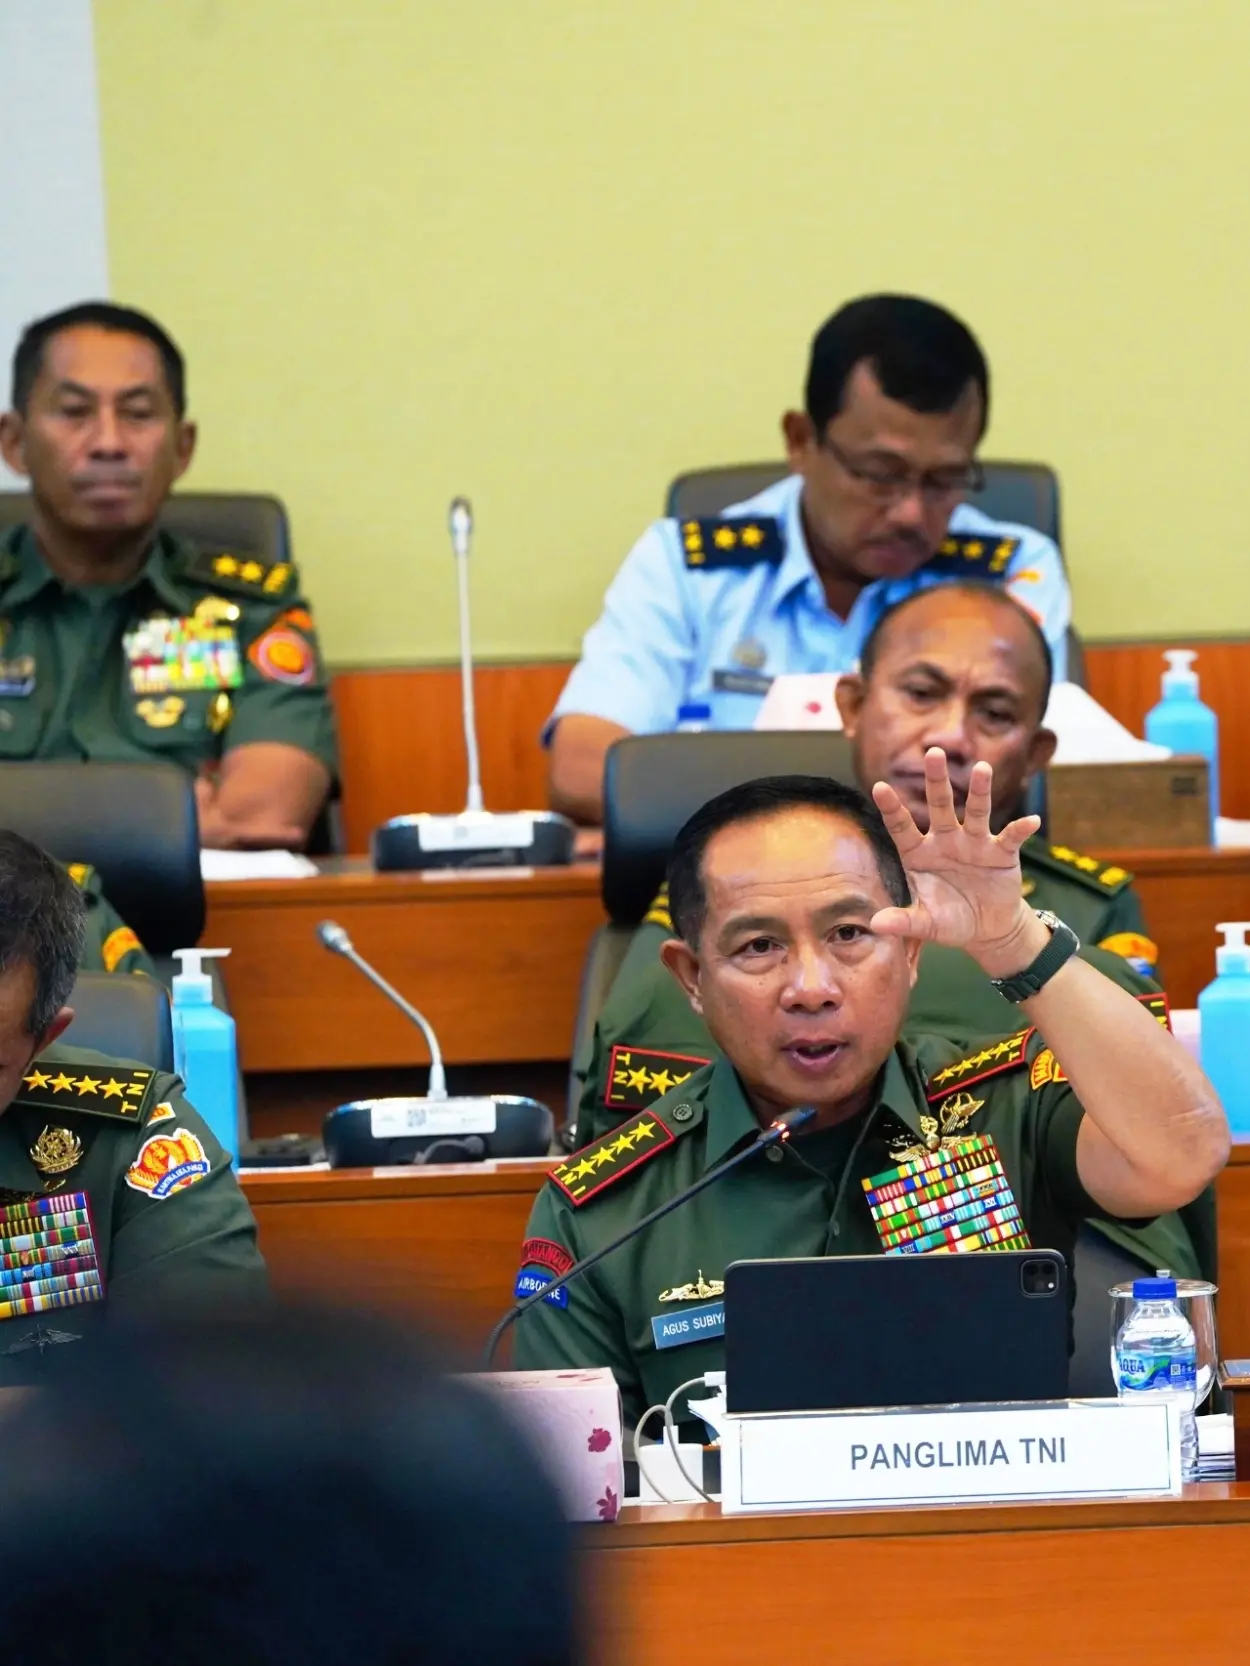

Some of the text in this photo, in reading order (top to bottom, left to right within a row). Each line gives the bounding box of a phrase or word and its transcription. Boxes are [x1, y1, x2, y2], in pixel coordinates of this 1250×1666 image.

[120, 1072, 150, 1113] TNI
[611, 1052, 631, 1100] TNI
[553, 1164, 587, 1196] TNI
[662, 1320, 690, 1336] AGUS
[1119, 1358, 1146, 1375] AQUA
[851, 1437, 1066, 1471] PANGLIMA TNI
